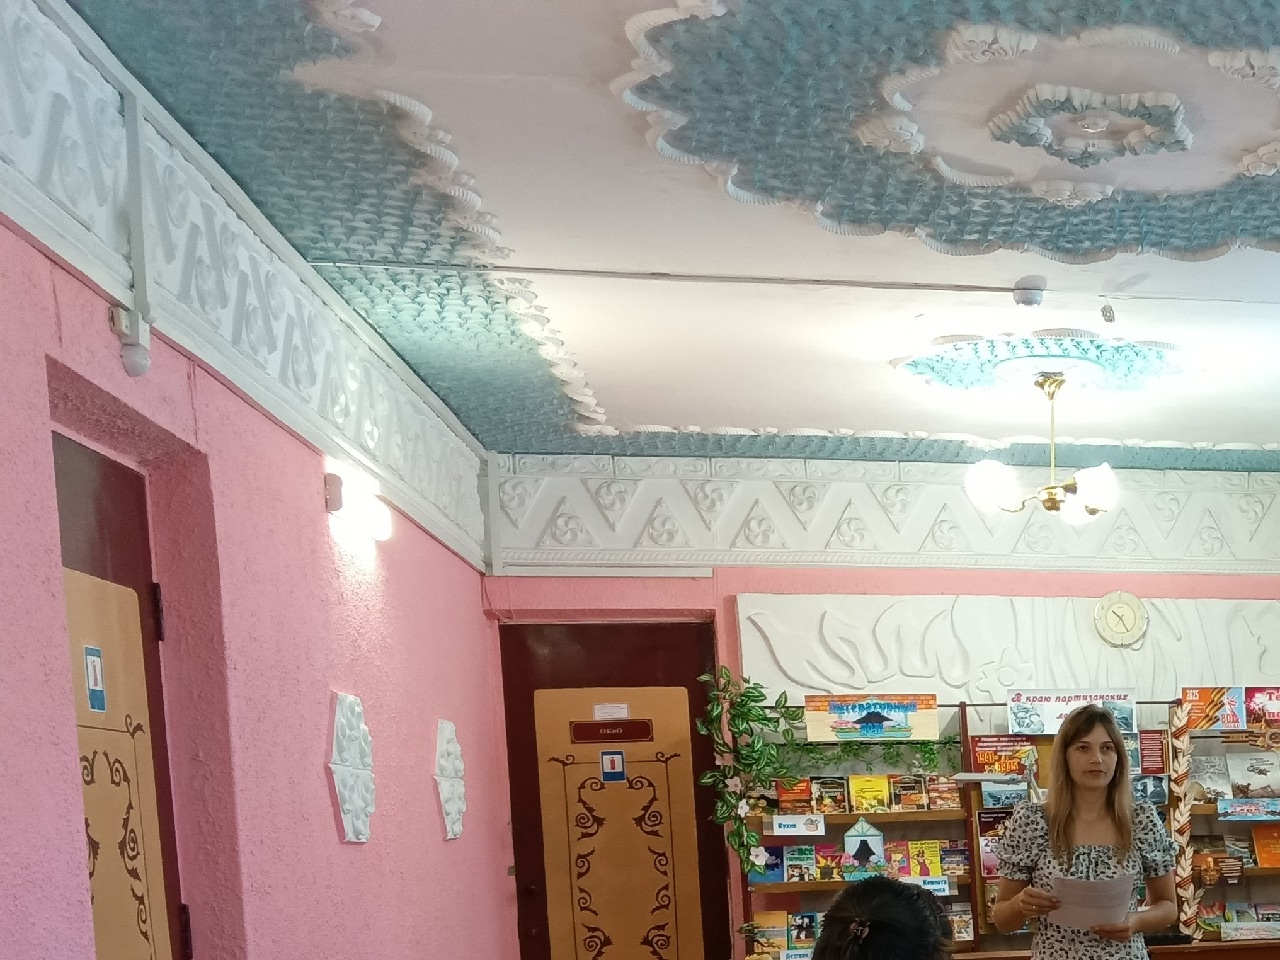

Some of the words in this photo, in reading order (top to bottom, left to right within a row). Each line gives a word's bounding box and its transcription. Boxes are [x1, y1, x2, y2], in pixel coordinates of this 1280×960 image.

[1011, 692, 1023, 703] В
[1025, 694, 1051, 705] краю
[1054, 693, 1129, 706] партизанских
[1185, 689, 1200, 701] 2025
